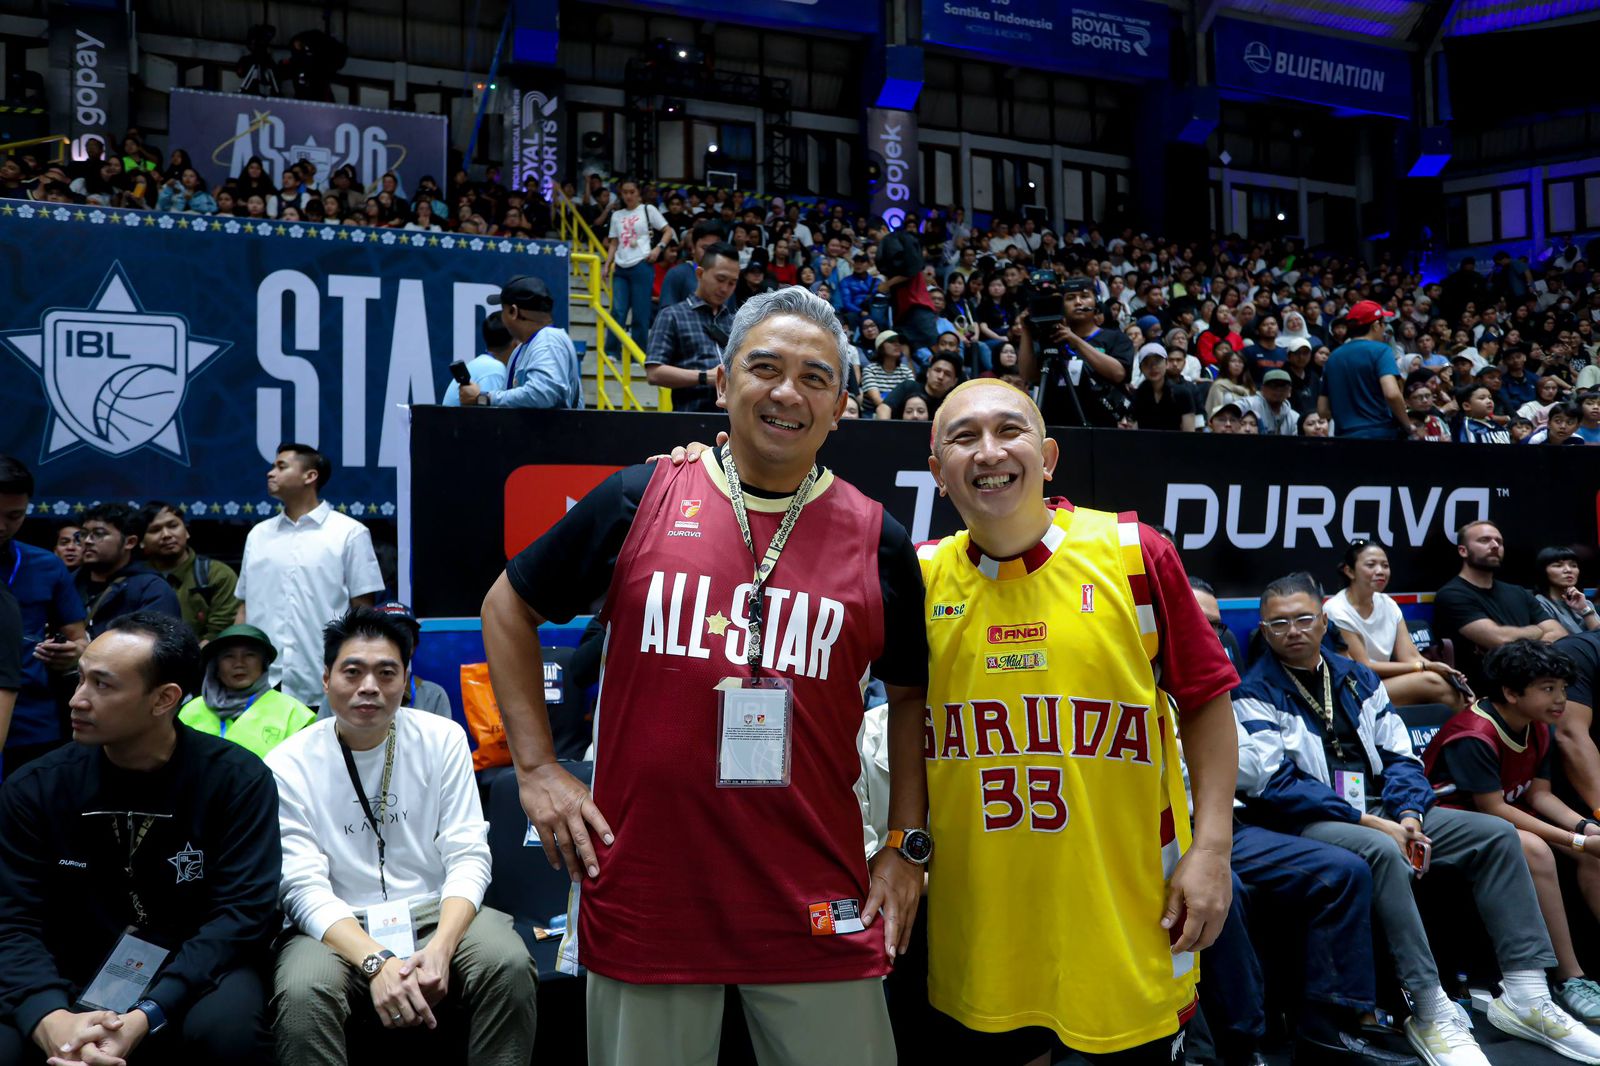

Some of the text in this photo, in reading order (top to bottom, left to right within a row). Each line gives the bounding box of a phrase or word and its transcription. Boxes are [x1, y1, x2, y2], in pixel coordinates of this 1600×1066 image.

[944, 3, 1053, 31] Santika Indonesia
[1072, 16, 1121, 37] ROYAL
[1072, 31, 1132, 54] SPORTS
[75, 29, 106, 125] gopay
[1275, 51, 1385, 92] BLUENATION
[230, 113, 286, 191] AS
[880, 124, 910, 200] gojek
[65, 330, 131, 360] IBL
[640, 571, 845, 680] ALL STAR
[998, 654, 1023, 668] Mild
[979, 766, 1069, 832] 33
